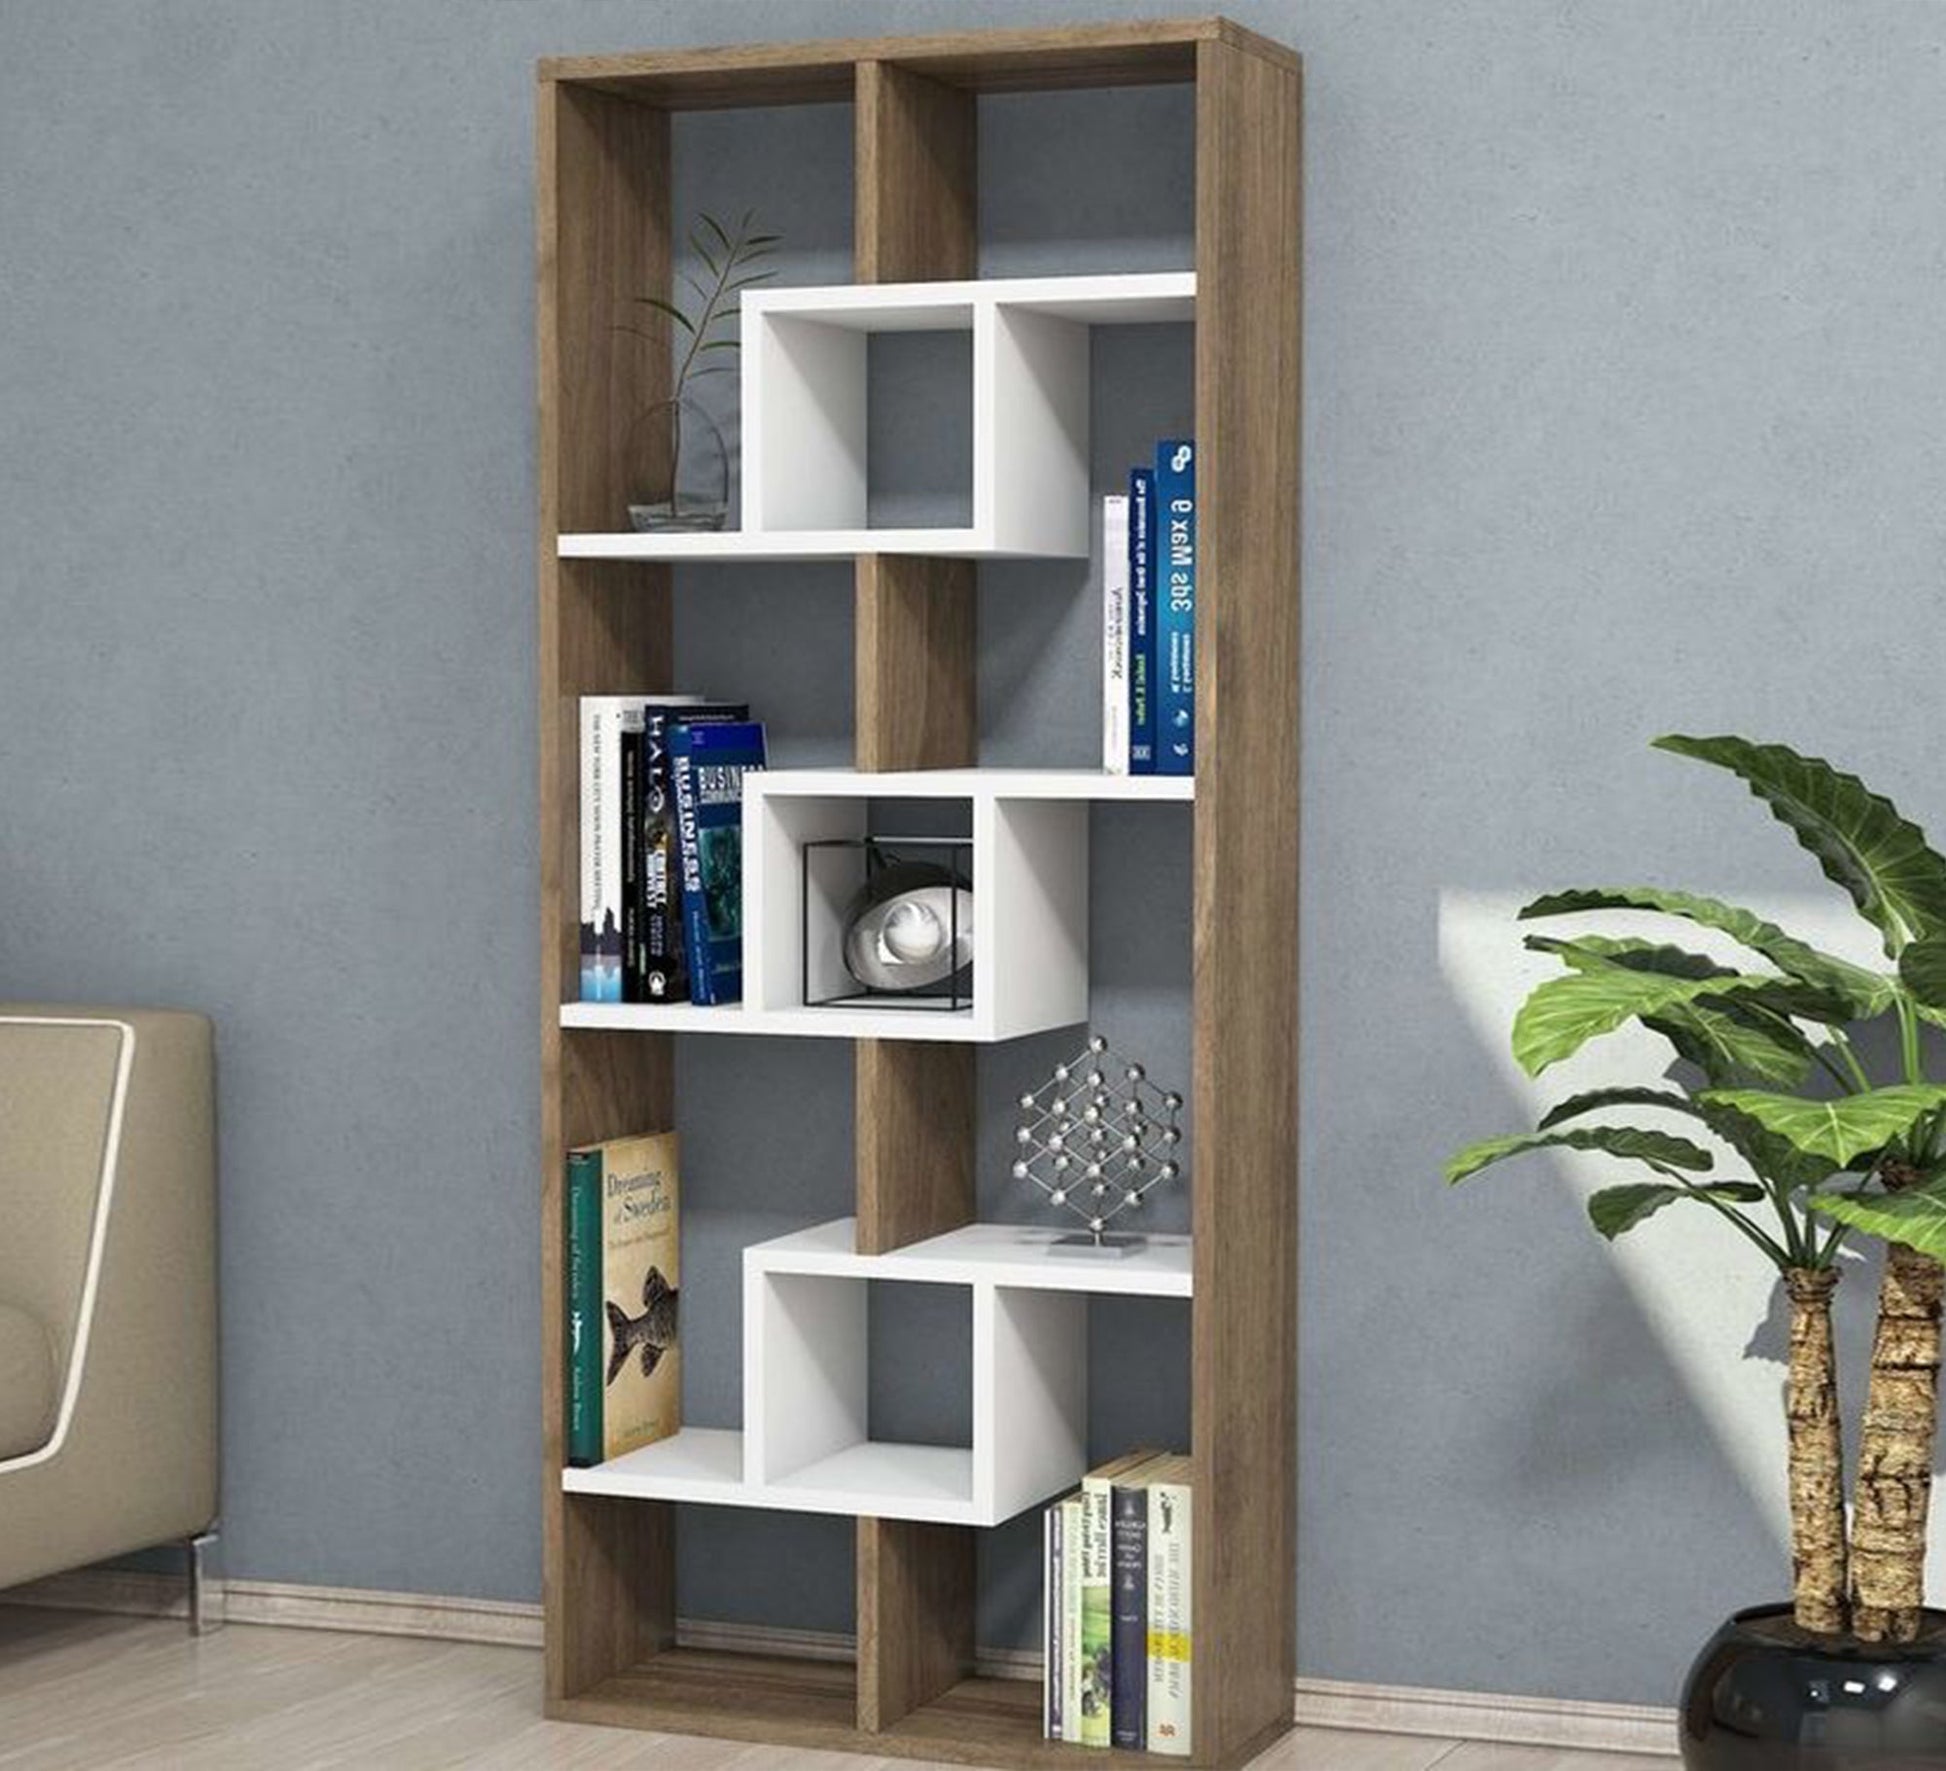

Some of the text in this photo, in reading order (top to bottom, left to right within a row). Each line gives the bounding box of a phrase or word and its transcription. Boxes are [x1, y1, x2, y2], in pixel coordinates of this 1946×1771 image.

[647, 715, 665, 813] HALO
[679, 755, 701, 892] BUSINESS
[606, 1169, 662, 1198] Dreaming
[624, 1189, 672, 1223] Sweden
